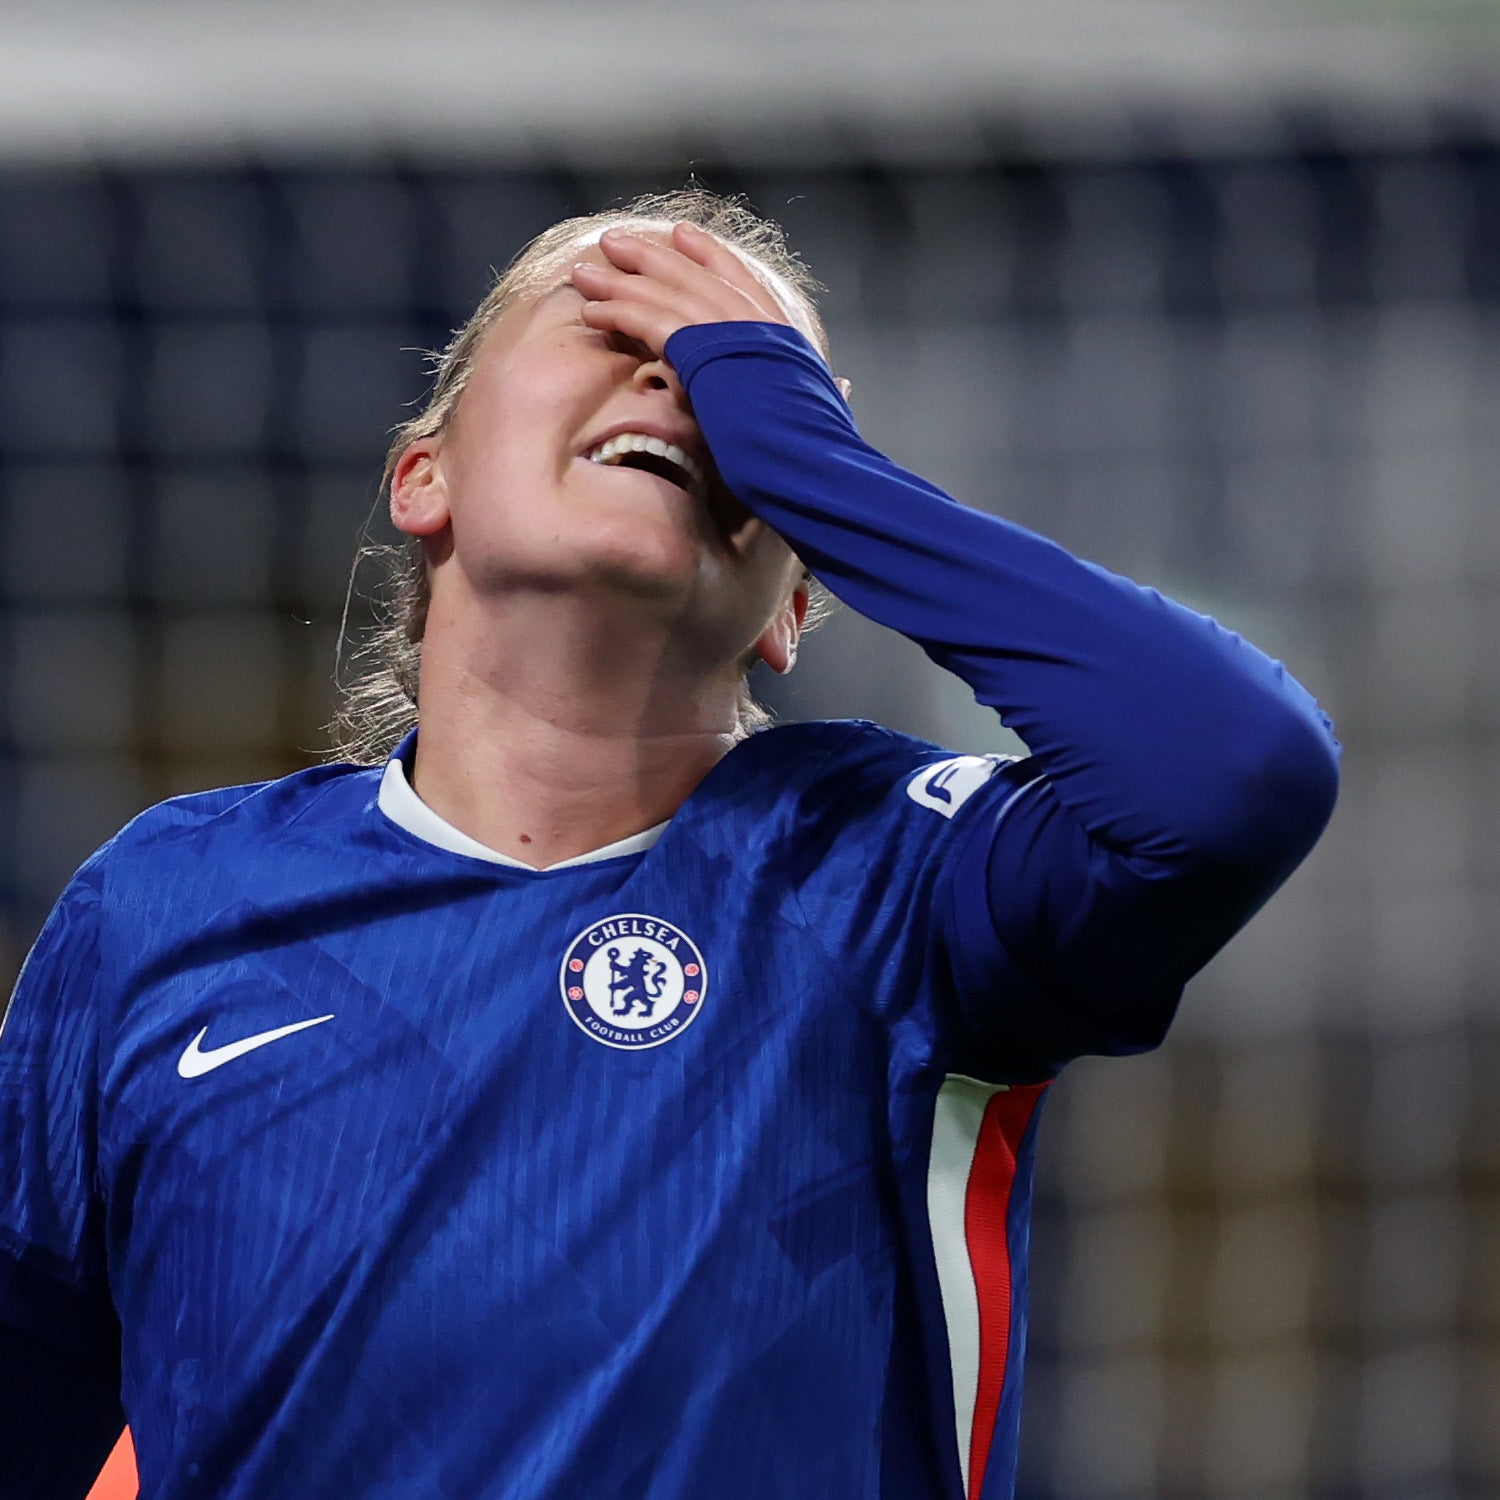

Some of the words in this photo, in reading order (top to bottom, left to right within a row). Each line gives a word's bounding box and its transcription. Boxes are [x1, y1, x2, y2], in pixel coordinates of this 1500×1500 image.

[588, 920, 681, 951] CHELSEA
[584, 1016, 645, 1042] FOOTBALL
[650, 1018, 680, 1039] CLUB
